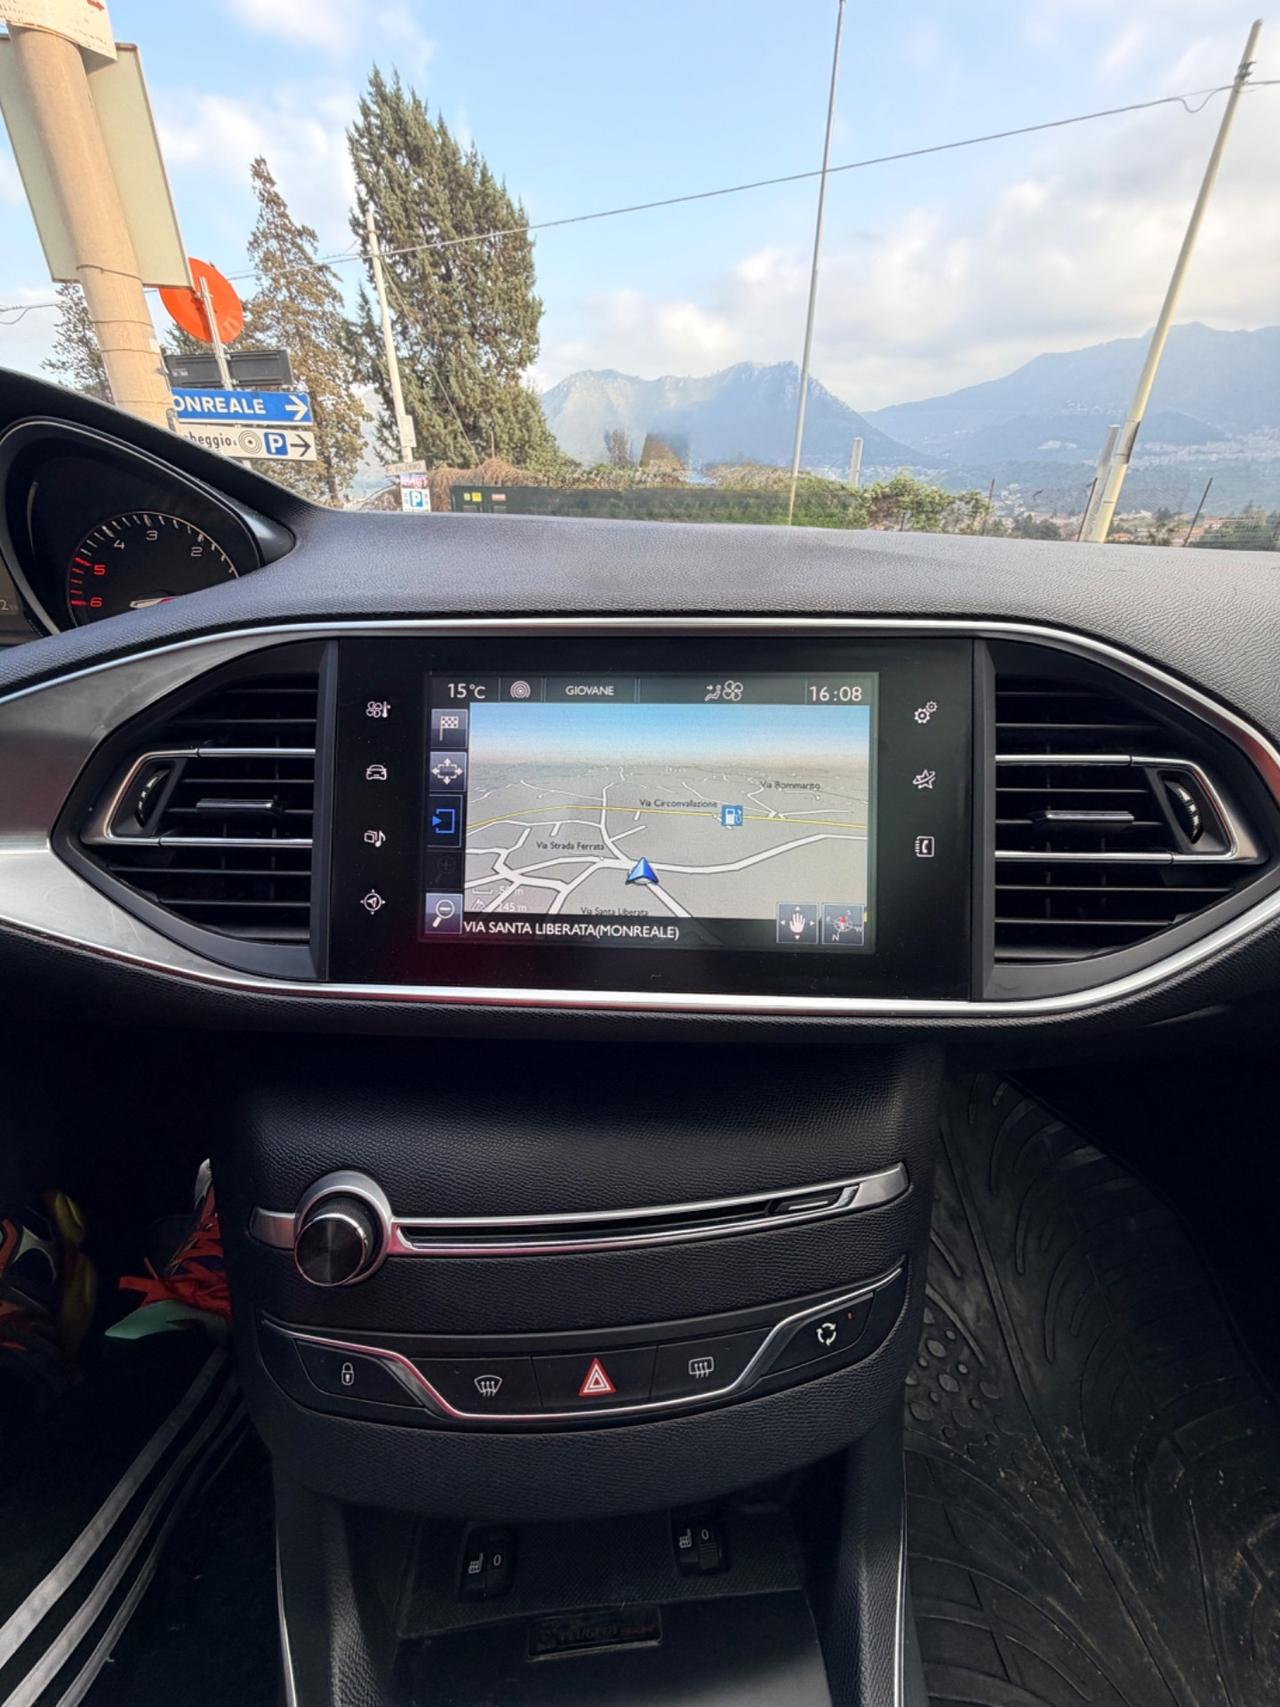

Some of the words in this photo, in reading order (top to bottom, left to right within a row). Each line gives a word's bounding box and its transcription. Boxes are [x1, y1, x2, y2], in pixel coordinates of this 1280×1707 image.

[173, 395, 266, 415] ONREALE
[267, 434, 283, 453] P
[146, 530, 158, 541] 3
[113, 539, 125, 550] 4
[190, 546, 203, 557] 2
[93, 565, 106, 576] 5
[89, 597, 103, 608] 6
[565, 685, 615, 696] GIOVANE
[809, 686, 862, 702] 16:08
[760, 780, 772, 789] Via
[639, 799, 652, 808] Via
[536, 841, 548, 849] Via
[550, 841, 575, 850] Strada
[576, 842, 605, 851] Ferrata
[581, 906, 592, 915] Via
[595, 906, 616, 916] Santa
[618, 907, 649, 917] Liberata
[464, 921, 486, 934] VIA
[489, 921, 532, 935] SANTA
[535, 923, 679, 941] LIBERATA(MONREALE)
[832, 933, 840, 942] N
[701, 1528, 709, 1541] 0
[493, 1554, 501, 1567] 0
